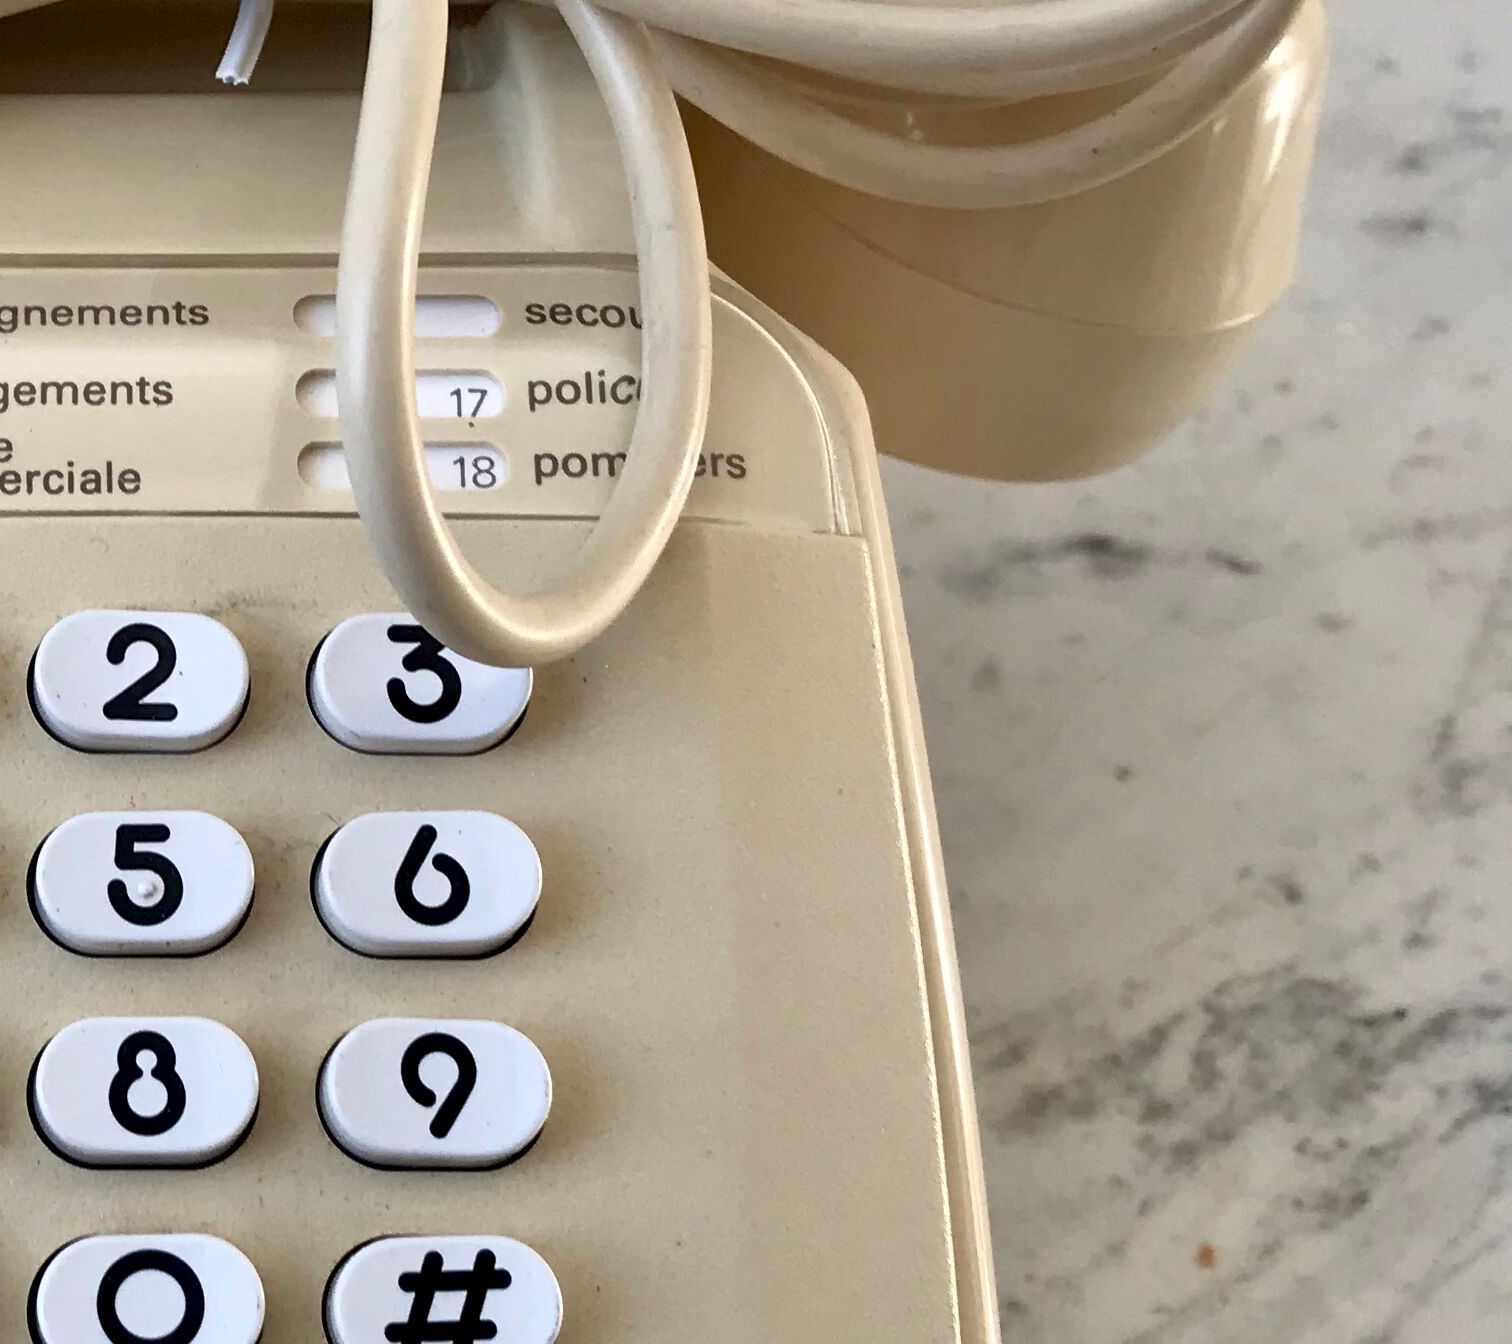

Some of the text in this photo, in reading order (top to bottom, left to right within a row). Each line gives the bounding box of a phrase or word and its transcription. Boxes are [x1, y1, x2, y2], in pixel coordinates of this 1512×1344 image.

[451, 370, 642, 417] 17 polic
[454, 452, 747, 488] 18 pomers
[102, 623, 178, 722] 2
[386, 624, 462, 724] 3
[107, 824, 184, 927] 5
[394, 824, 471, 927] 6
[108, 1030, 187, 1137] 8
[400, 1032, 477, 1139] 9
